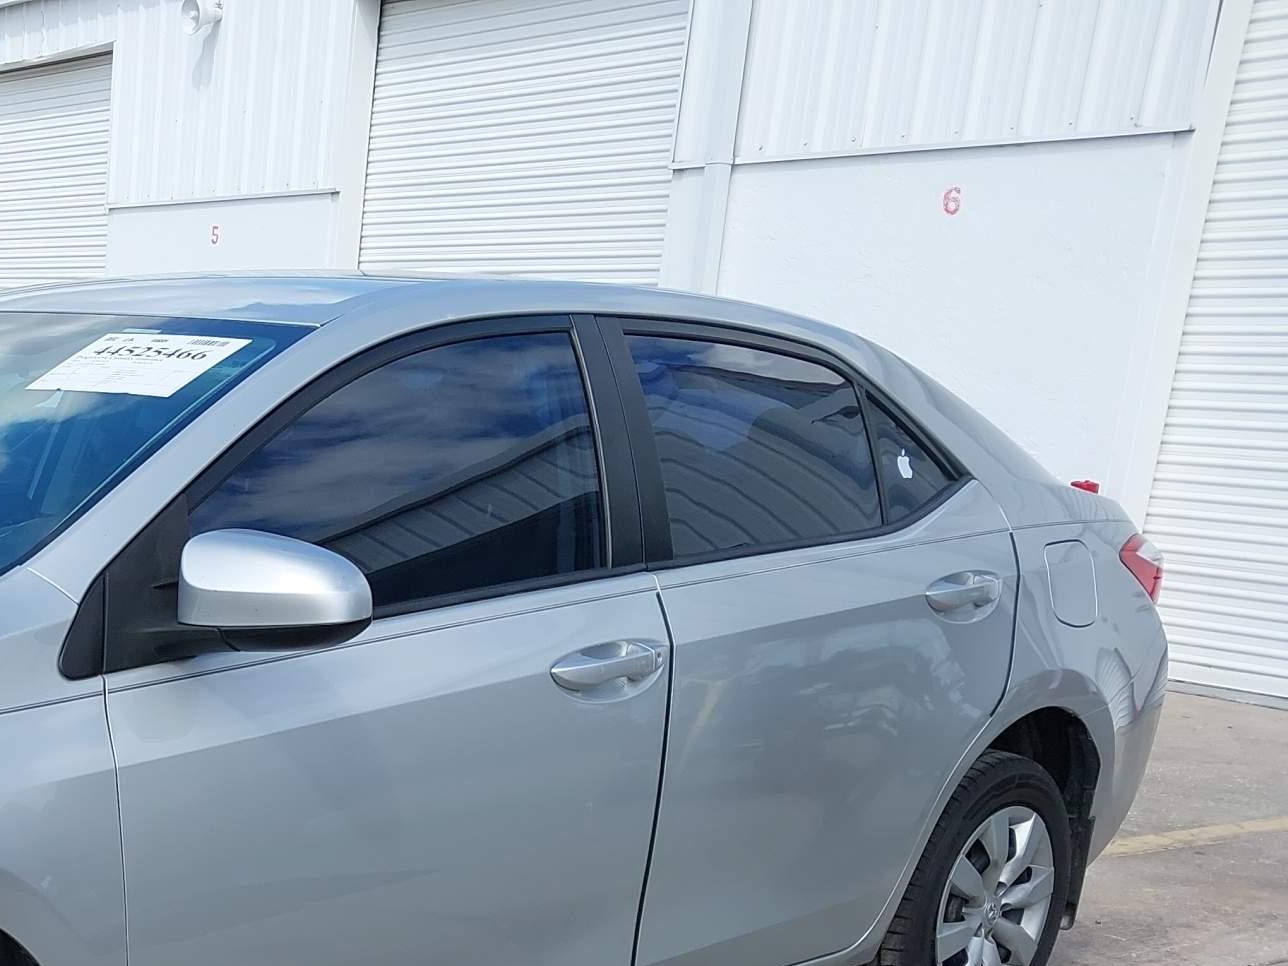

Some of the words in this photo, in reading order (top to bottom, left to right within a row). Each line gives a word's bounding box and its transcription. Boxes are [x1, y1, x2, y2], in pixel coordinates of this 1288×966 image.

[943, 186, 961, 216] 6
[210, 225, 219, 245] 5
[93, 344, 211, 361] 44525466
